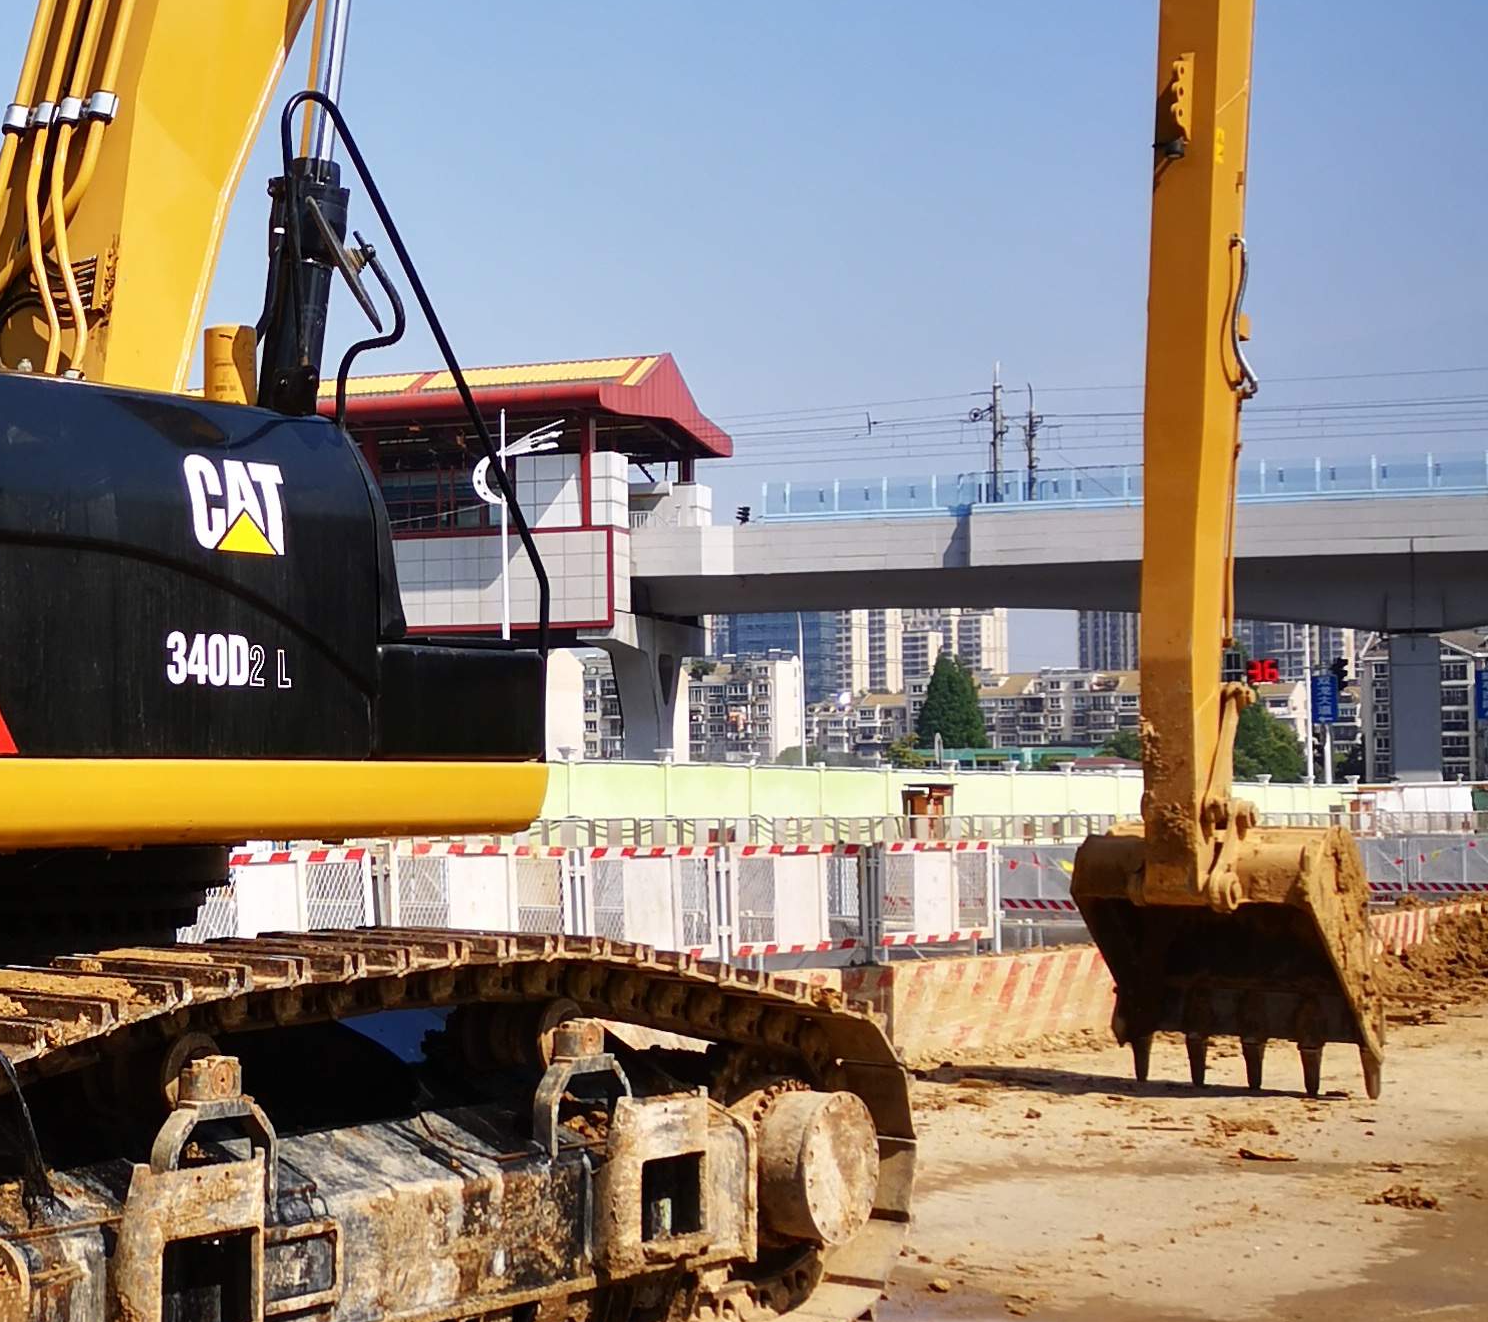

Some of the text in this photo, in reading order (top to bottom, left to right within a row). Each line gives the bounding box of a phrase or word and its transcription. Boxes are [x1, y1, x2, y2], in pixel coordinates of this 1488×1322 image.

[184, 454, 285, 556] CAT
[166, 630, 292, 689] 340D2 L
